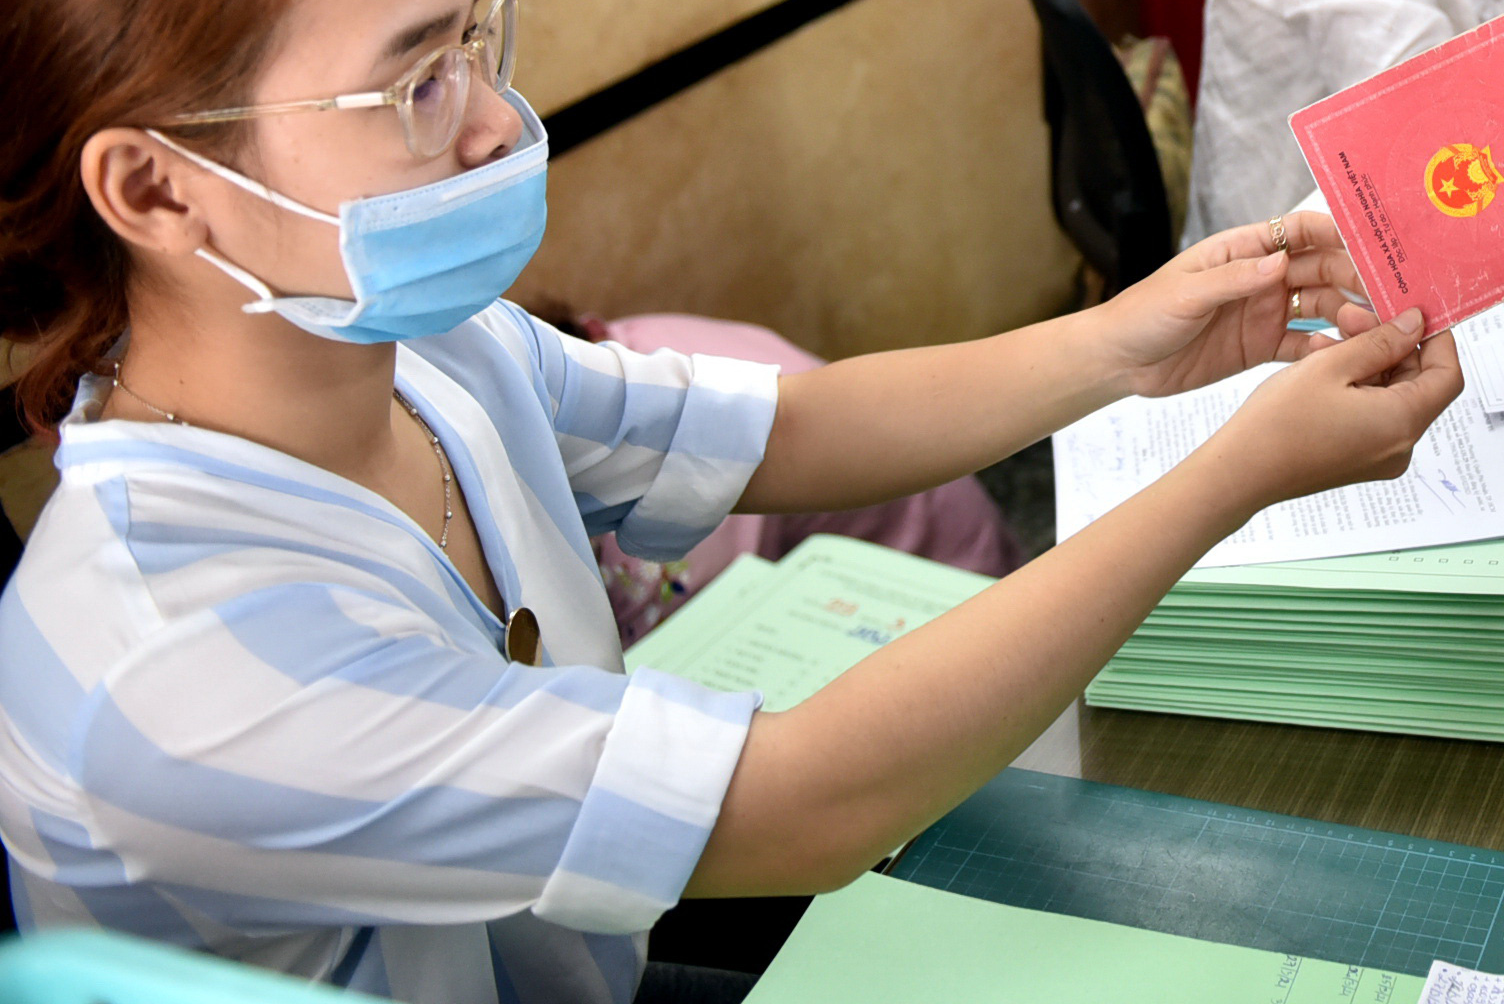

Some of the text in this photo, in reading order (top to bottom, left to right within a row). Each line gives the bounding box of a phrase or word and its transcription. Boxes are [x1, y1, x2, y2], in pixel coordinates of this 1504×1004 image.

[1338, 151, 1409, 294] CỘNG HÒA XÃ HỘI CHỦ NGHĨA VIỆT NAM
